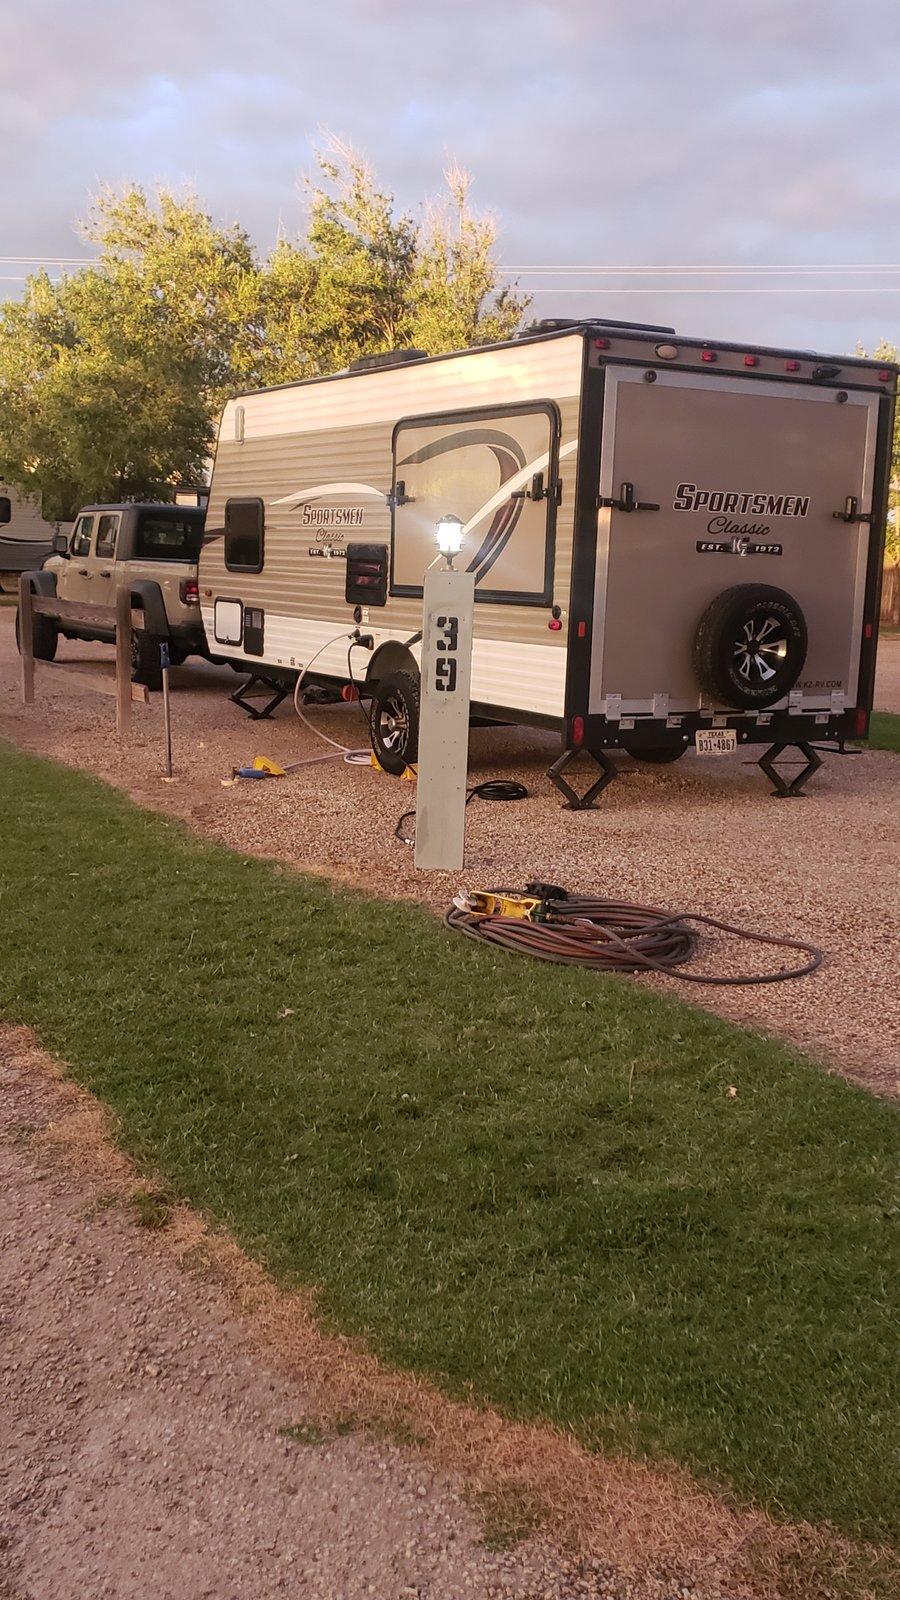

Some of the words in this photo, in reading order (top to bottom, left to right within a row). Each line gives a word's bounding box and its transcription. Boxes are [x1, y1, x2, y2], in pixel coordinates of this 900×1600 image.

[674, 483, 811, 517] SPORTSMEN
[302, 503, 364, 525] SPORTSMEN
[707, 516, 771, 535] Classic
[755, 545, 780, 553] 1972
